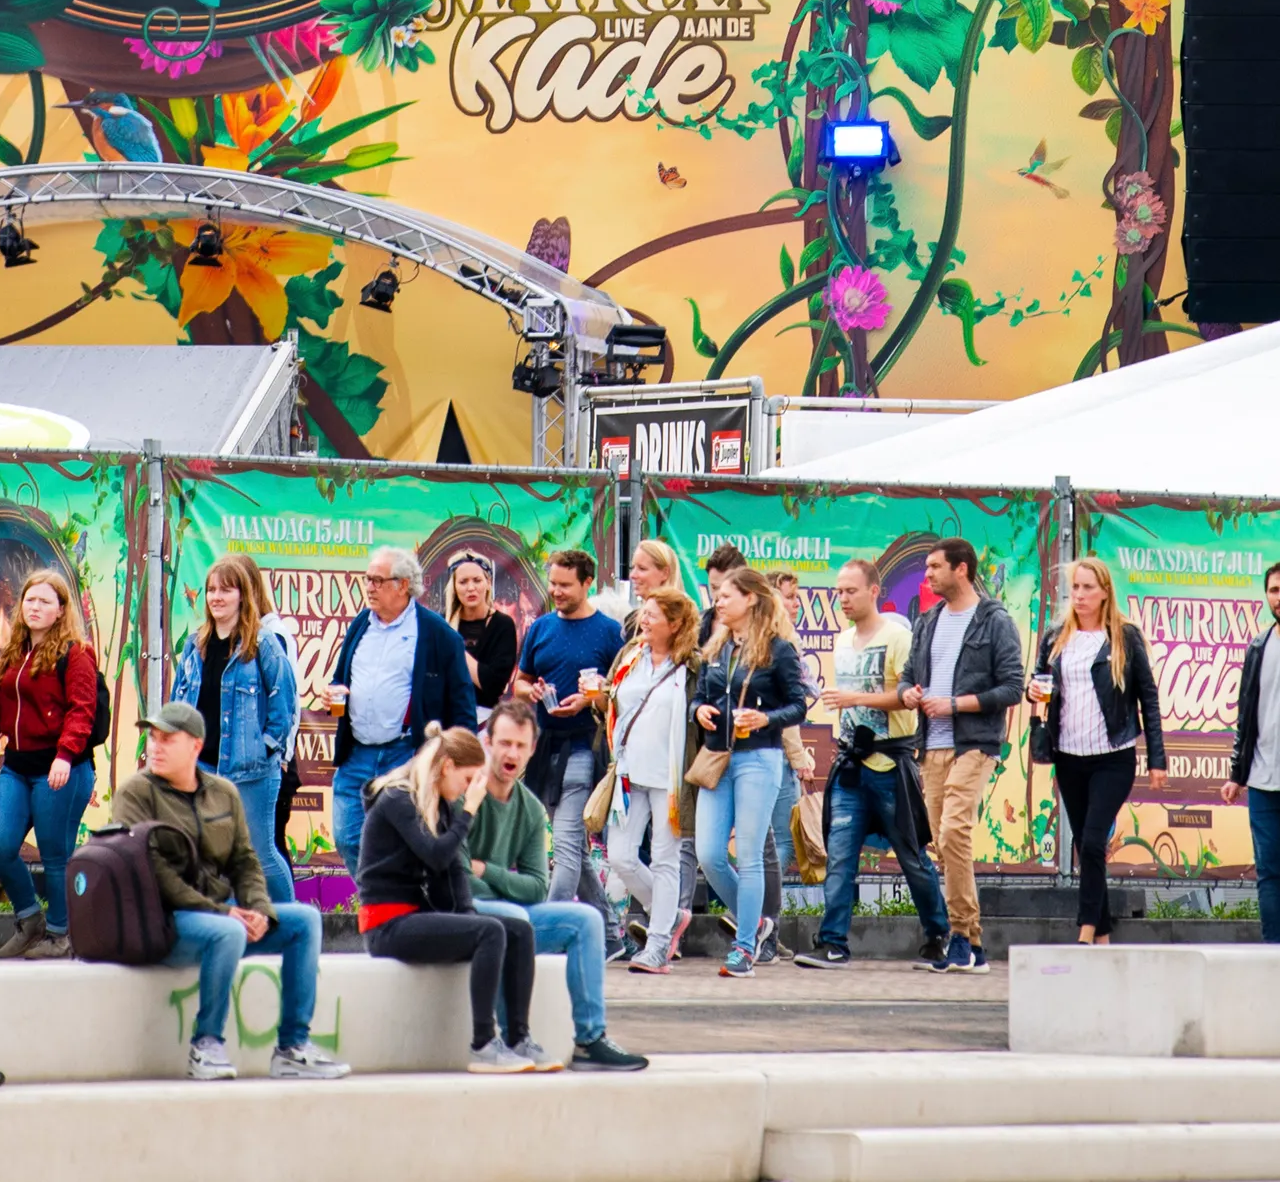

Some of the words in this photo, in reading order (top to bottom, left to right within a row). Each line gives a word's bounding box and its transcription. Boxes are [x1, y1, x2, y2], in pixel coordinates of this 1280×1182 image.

[604, 18, 645, 38] LIVE
[683, 17, 725, 38] AAN
[726, 17, 751, 37] DE
[635, 420, 707, 474] DRINKS
[221, 515, 312, 544] MAANDAG
[315, 519, 332, 544] 15
[333, 520, 375, 545] JULI
[774, 536, 791, 559] 16
[792, 536, 831, 560] JULI
[1117, 546, 1209, 573] WOENSDAG
[1212, 550, 1226, 574] 17
[1227, 551, 1263, 575] JULI
[302, 619, 323, 636] LIVE
[1127, 596, 1263, 646] MATRIXX
[821, 635, 833, 650] DE
[1194, 646, 1213, 662] LIVE
